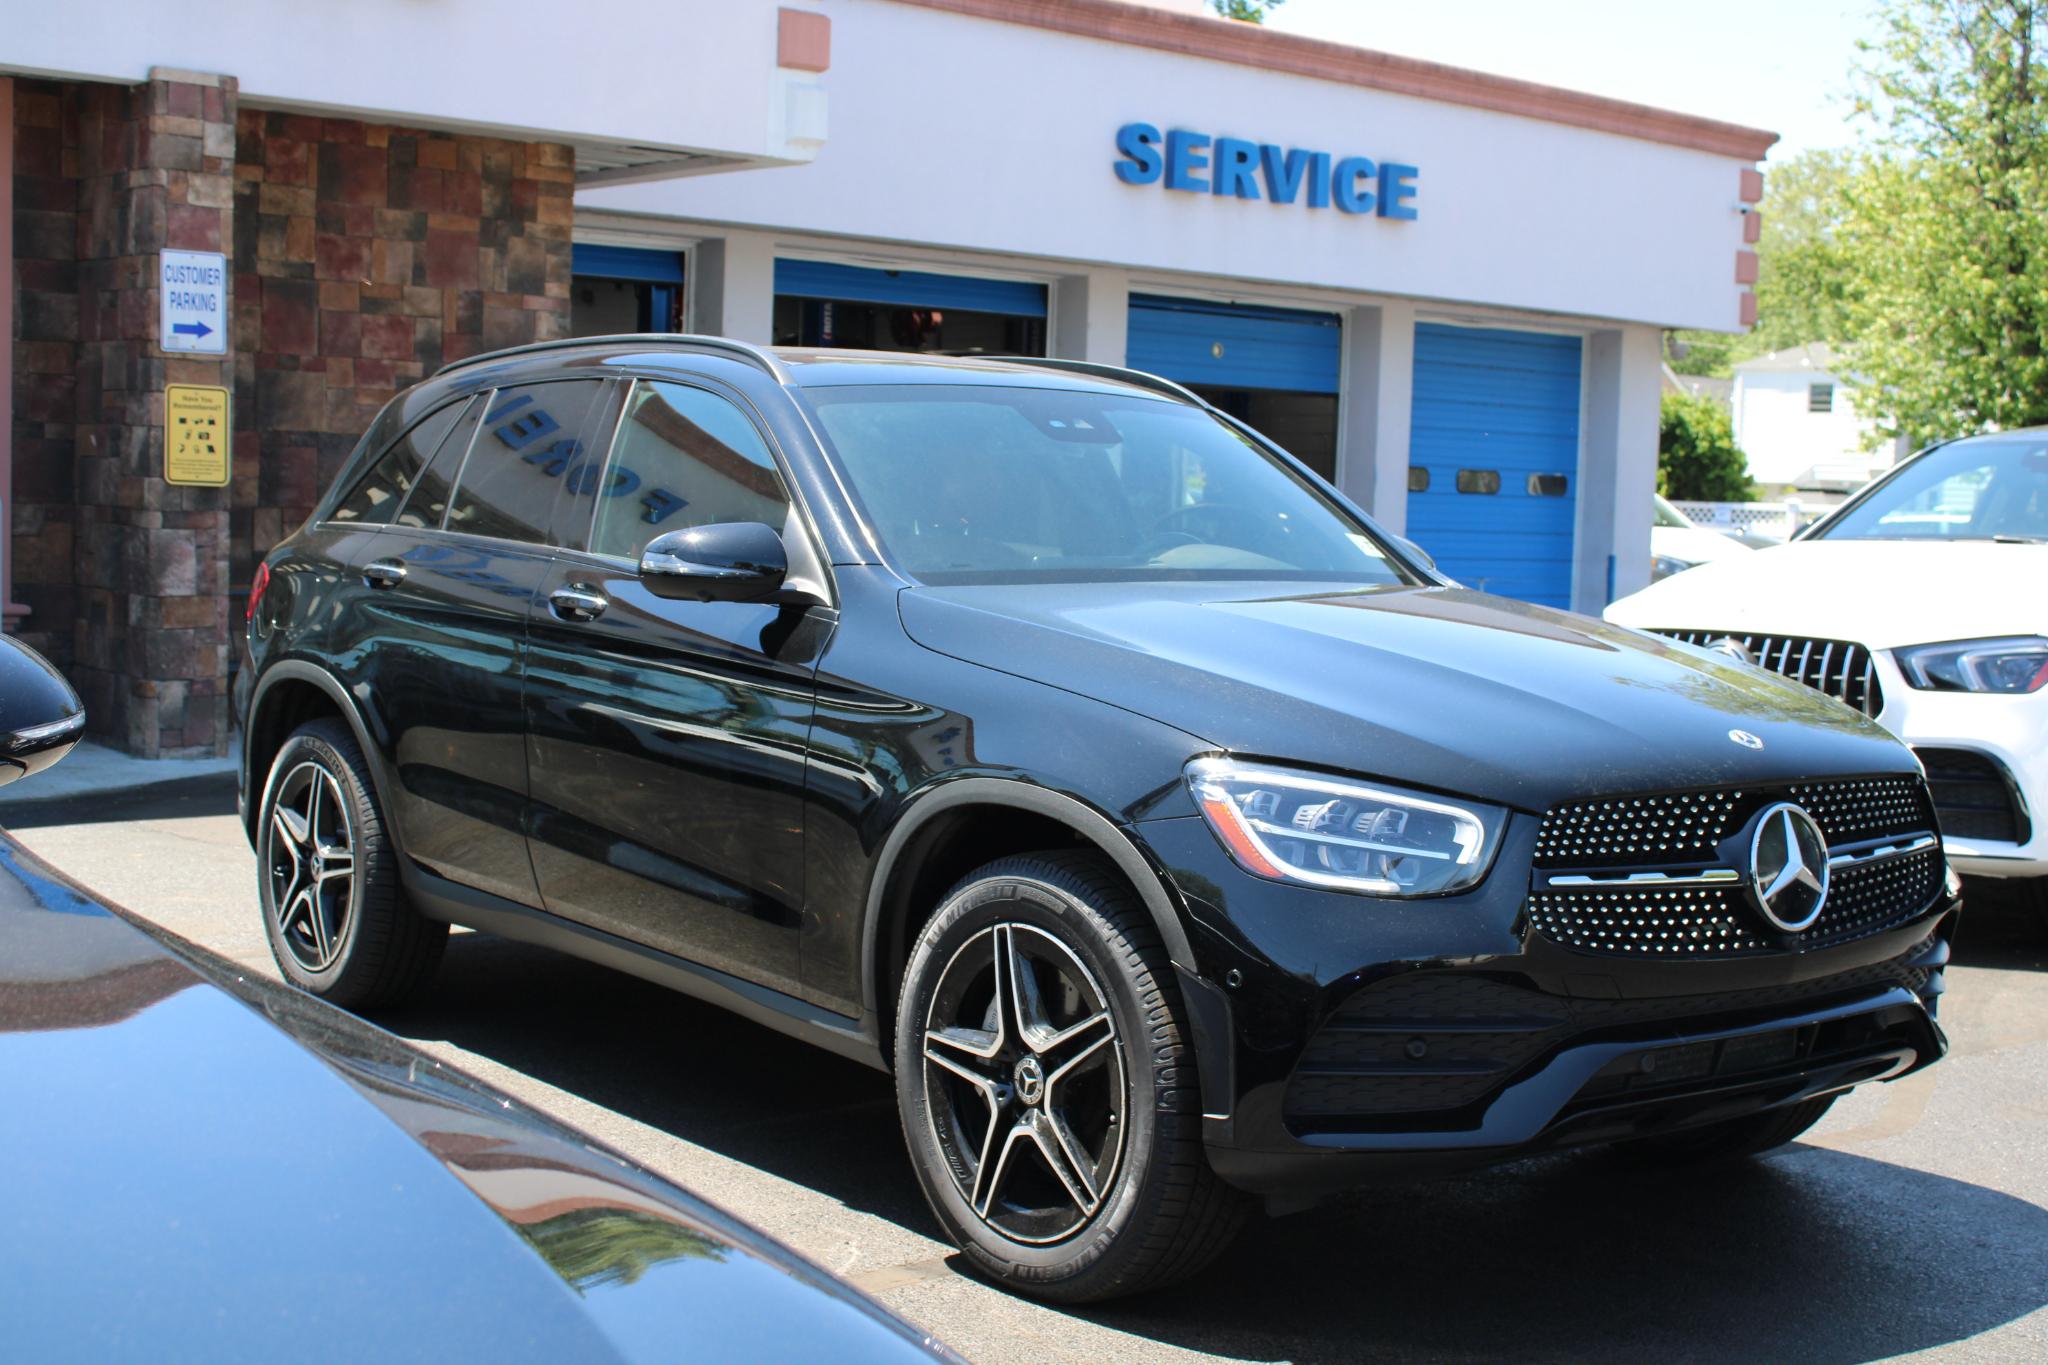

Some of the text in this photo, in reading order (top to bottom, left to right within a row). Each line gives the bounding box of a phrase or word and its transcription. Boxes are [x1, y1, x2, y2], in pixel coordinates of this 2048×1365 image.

[1113, 123, 1419, 221] SERVICE
[164, 264, 220, 285] CUSTOMER
[170, 291, 216, 312] PARKING
[945, 885, 1018, 926] MICHELIN
